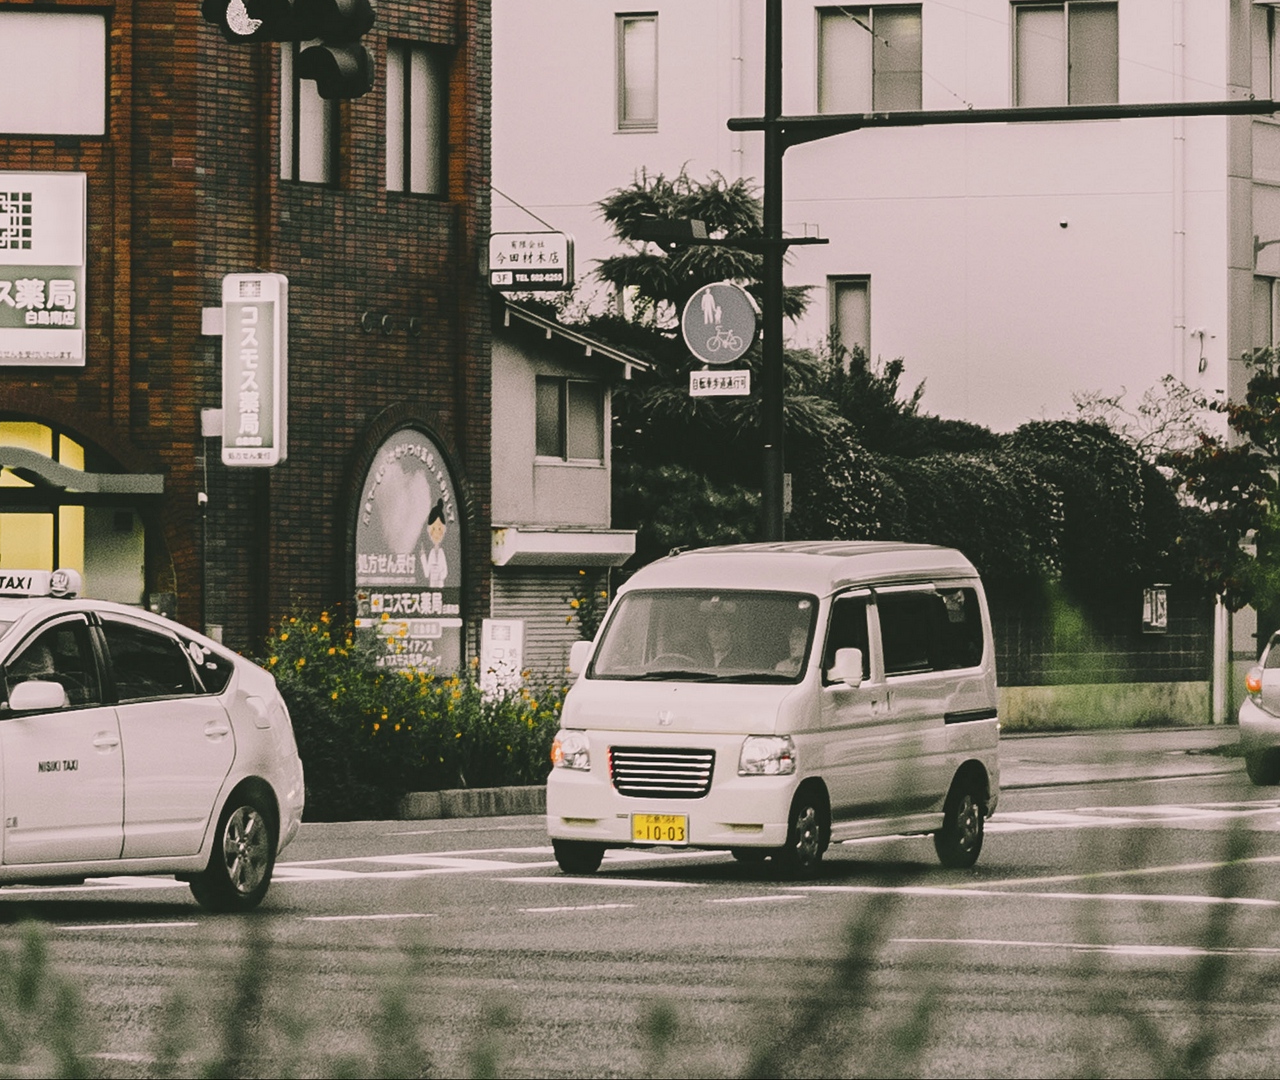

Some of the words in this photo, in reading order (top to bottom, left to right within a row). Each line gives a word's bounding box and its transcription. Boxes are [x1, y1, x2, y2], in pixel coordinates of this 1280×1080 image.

[496, 251, 559, 264] 今田材木店
[238, 306, 260, 435] コスモス薬局
[38, 761, 62, 773] NISIKI
[63, 760, 79, 771] TAXI
